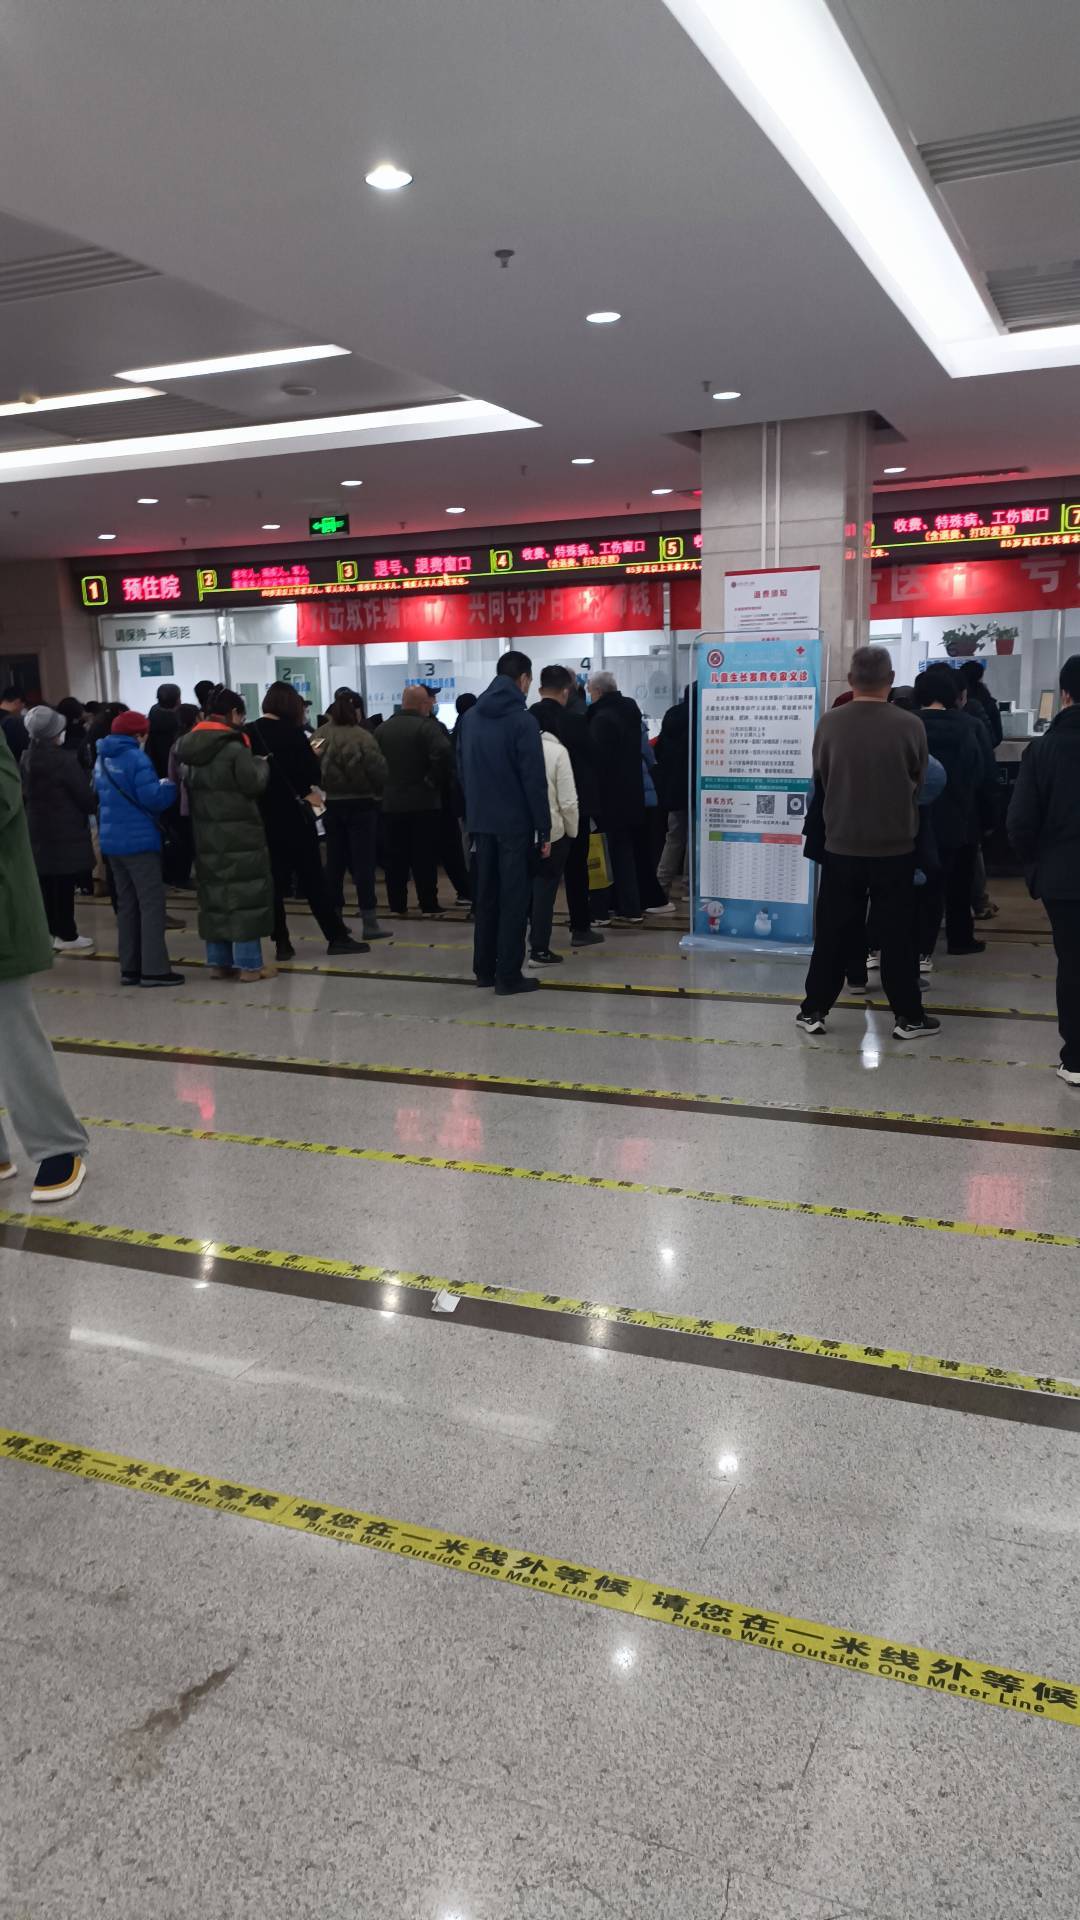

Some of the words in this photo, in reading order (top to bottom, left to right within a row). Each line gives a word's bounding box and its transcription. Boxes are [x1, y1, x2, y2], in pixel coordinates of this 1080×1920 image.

[894, 508, 1049, 533] 收费、特殊病、工伤窗口
[522, 540, 646, 561] 收费、特殊病、工伤窗口
[667, 541, 677, 555] 5
[343, 563, 353, 578] 3
[374, 556, 472, 577] 退号、退费窗口
[498, 554, 507, 568] 4
[122, 574, 182, 600] 预住院
[204, 573, 214, 586] 2
[88, 582, 99, 600] 1
[425, 663, 435, 676] 3
[580, 657, 591, 670] 4
[282, 668, 291, 681] 2
[616, 1314, 648, 1326] Wait
[658, 1323, 715, 1338] Outside
[726, 1333, 755, 1345] One
[815, 1348, 848, 1359] Line
[7, 1449, 49, 1465] Please
[52, 1459, 83, 1474] Wait
[85, 1468, 137, 1486] Outside
[140, 1481, 168, 1494] One
[170, 1488, 213, 1505] Meter
[215, 1499, 247, 1513] Line
[292, 1503, 632, 1598] 请您在一米线外等候
[304, 1521, 354, 1540] Please
[359, 1534, 396, 1551] Wait
[399, 1544, 461, 1566] Outside
[467, 1561, 500, 1576] One
[505, 1569, 557, 1590] Meter
[561, 1583, 599, 1601] Line
[651, 1591, 1078, 1710] 请您在一米线外等候
[671, 1612, 732, 1636] Please
[740, 1629, 785, 1649] Wait
[791, 1642, 870, 1670] Outside
[878, 1664, 919, 1682] One
[926, 1675, 990, 1700] Meter
[999, 1692, 1045, 1713] Line
